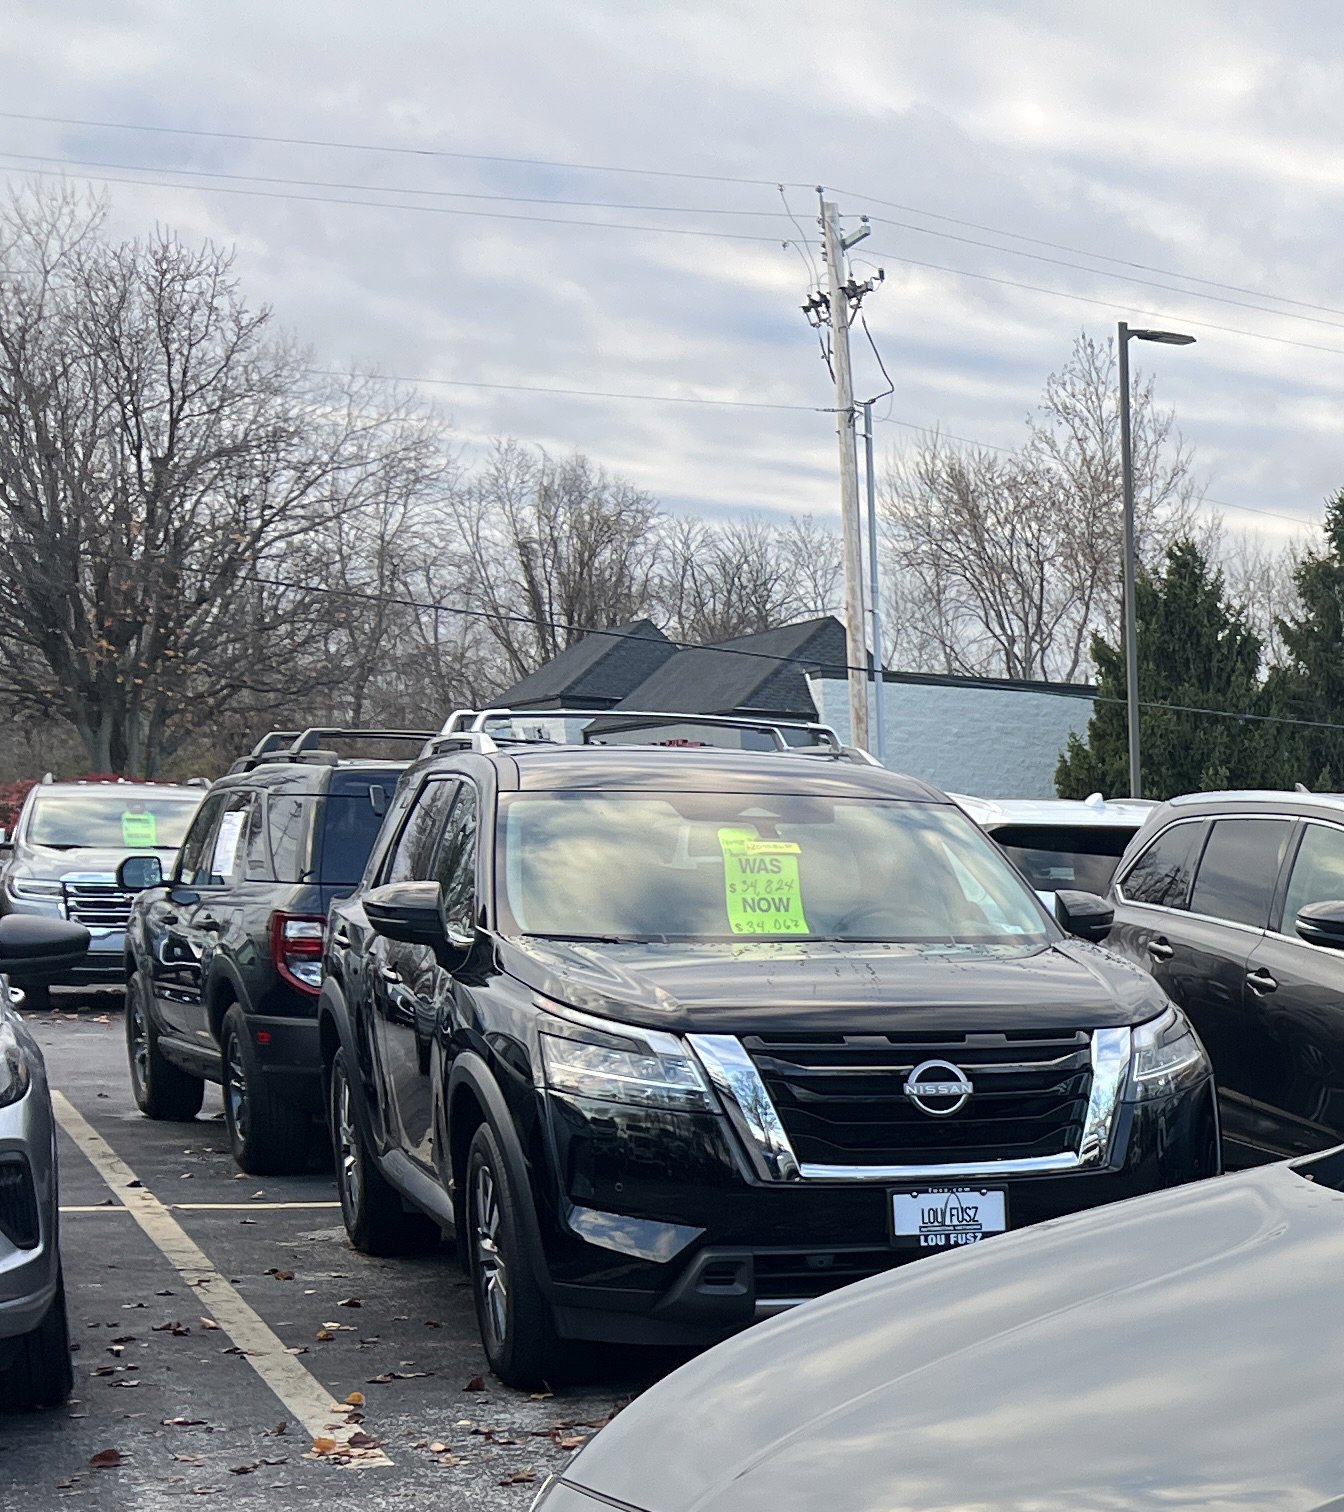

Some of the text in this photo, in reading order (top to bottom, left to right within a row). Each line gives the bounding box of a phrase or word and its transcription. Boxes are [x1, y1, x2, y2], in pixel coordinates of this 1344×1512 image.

[738, 858, 782, 874] WAS
[742, 897, 791, 913] NOW
[905, 1083, 973, 1095] NISSAN
[921, 1206, 979, 1225] LOU FUSZ
[920, 1234, 945, 1247] LOU
